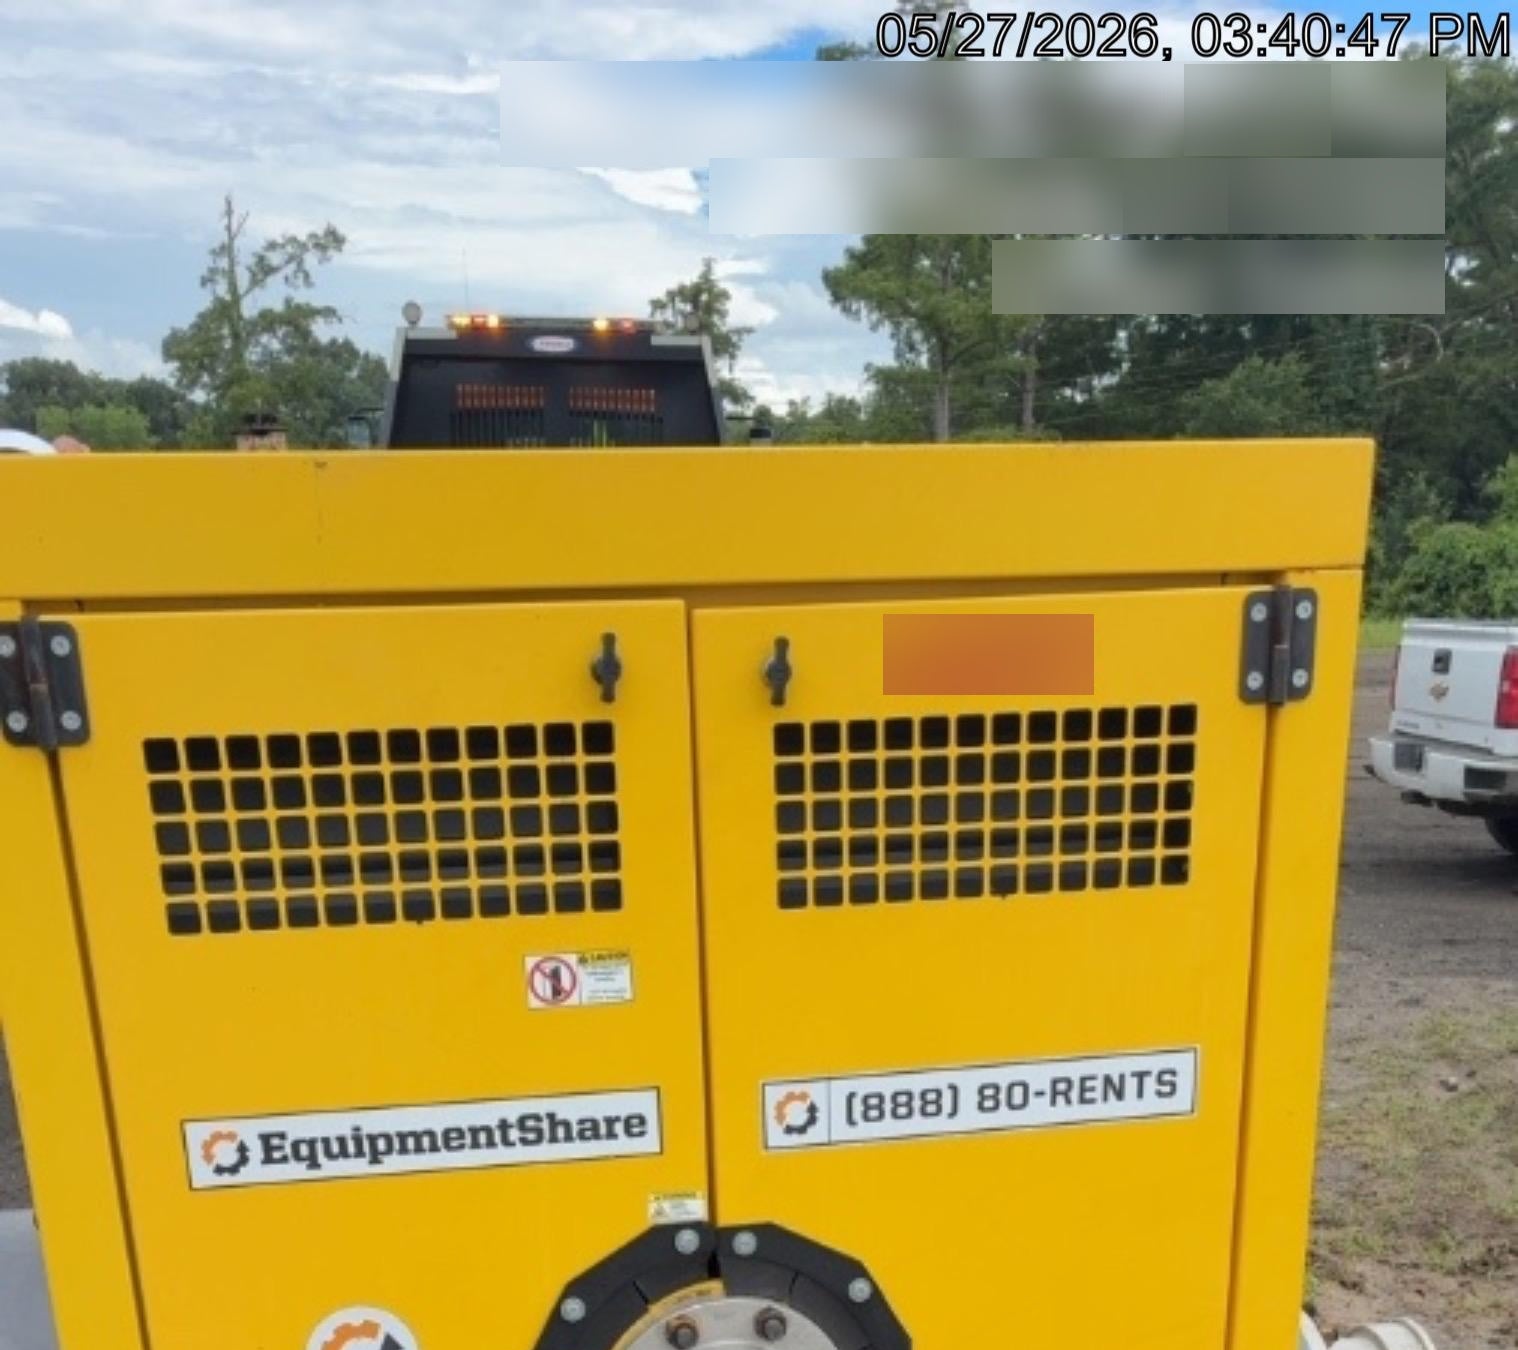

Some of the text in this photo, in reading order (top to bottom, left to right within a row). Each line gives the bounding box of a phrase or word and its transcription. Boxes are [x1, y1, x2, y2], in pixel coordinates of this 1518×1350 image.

[846, 1068, 1178, 1126] (888) 80-RENTS
[258, 1112, 647, 1168] EquipmentShare
